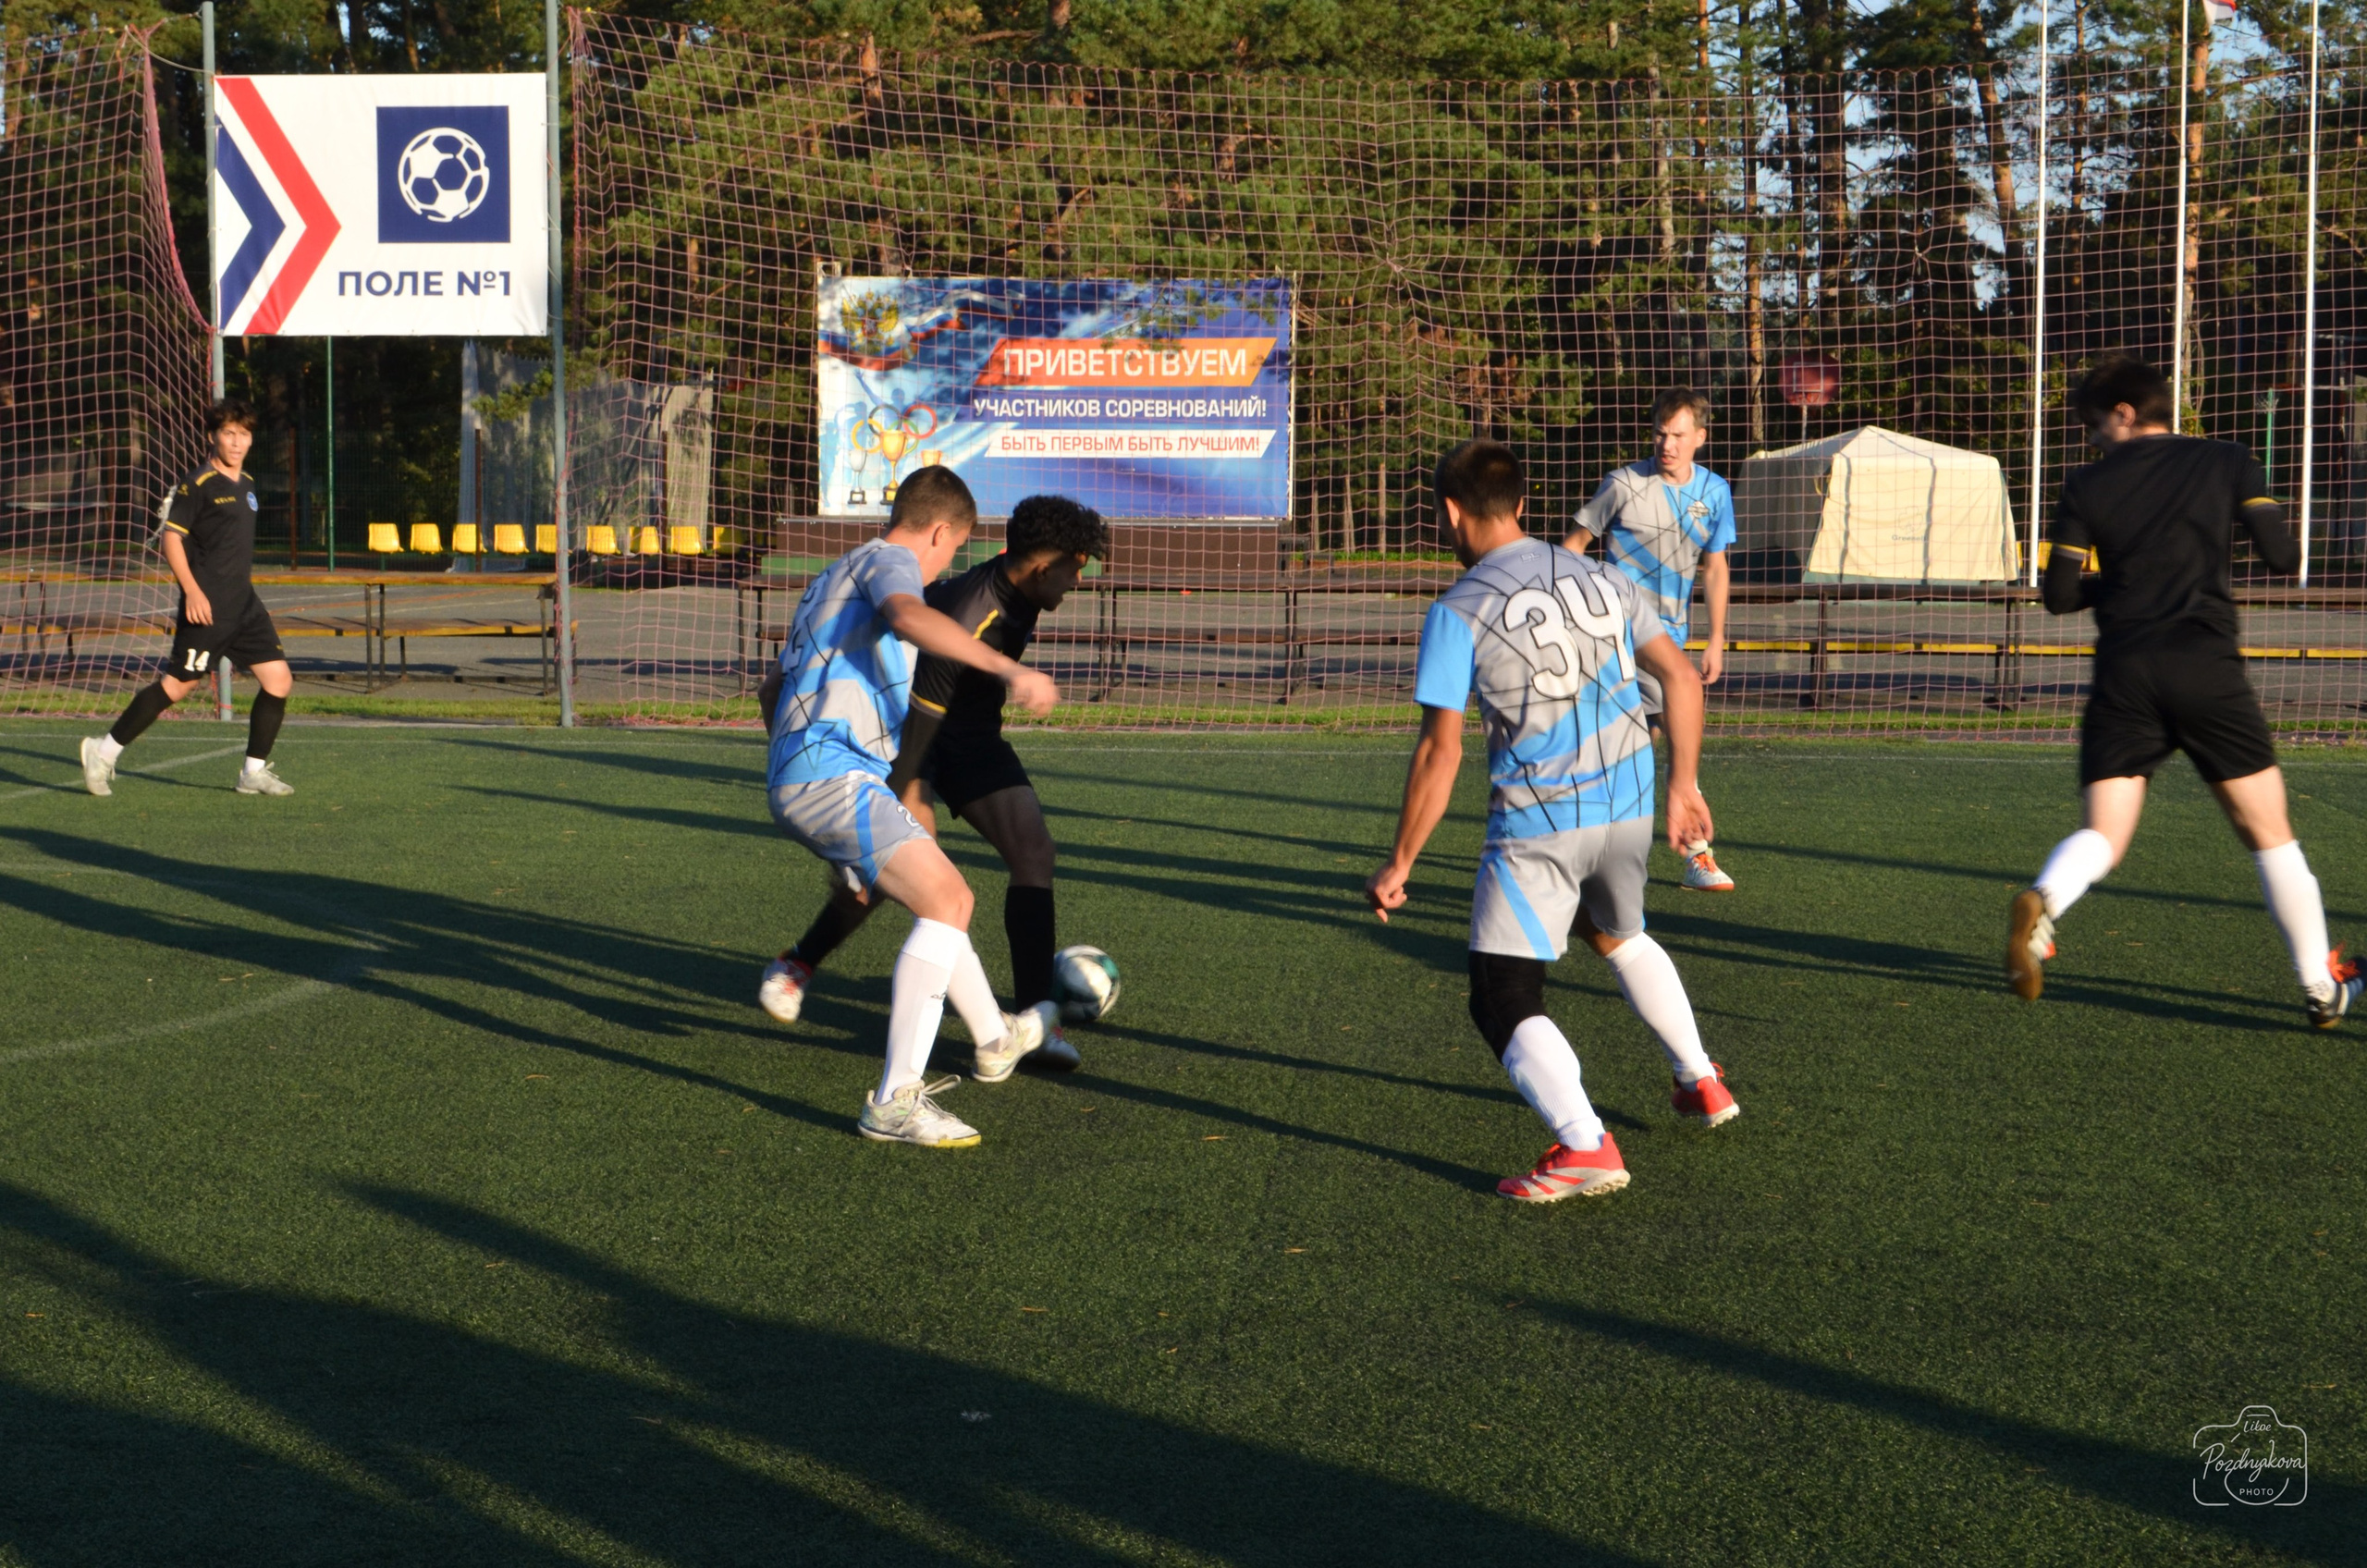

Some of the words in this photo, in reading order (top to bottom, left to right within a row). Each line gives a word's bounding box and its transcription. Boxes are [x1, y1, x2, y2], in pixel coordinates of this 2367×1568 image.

[338, 270, 444, 297] ПОЛЕ
[457, 270, 511, 297] №1
[1003, 348, 1247, 377] ПРИВЕТСТВУЕМ
[974, 398, 1101, 418] УЧАСТНИКОВ
[1105, 395, 1267, 418] СОРЕВНОВАНИЙ!
[1001, 436, 1046, 451] БЫТЬ
[1051, 436, 1123, 451] ПЕРВЫМ
[1127, 436, 1172, 451] БЫТЬ
[1177, 436, 1260, 451] ЛУЧШИМ!
[1503, 571, 1636, 700] 34
[184, 648, 211, 672] 14
